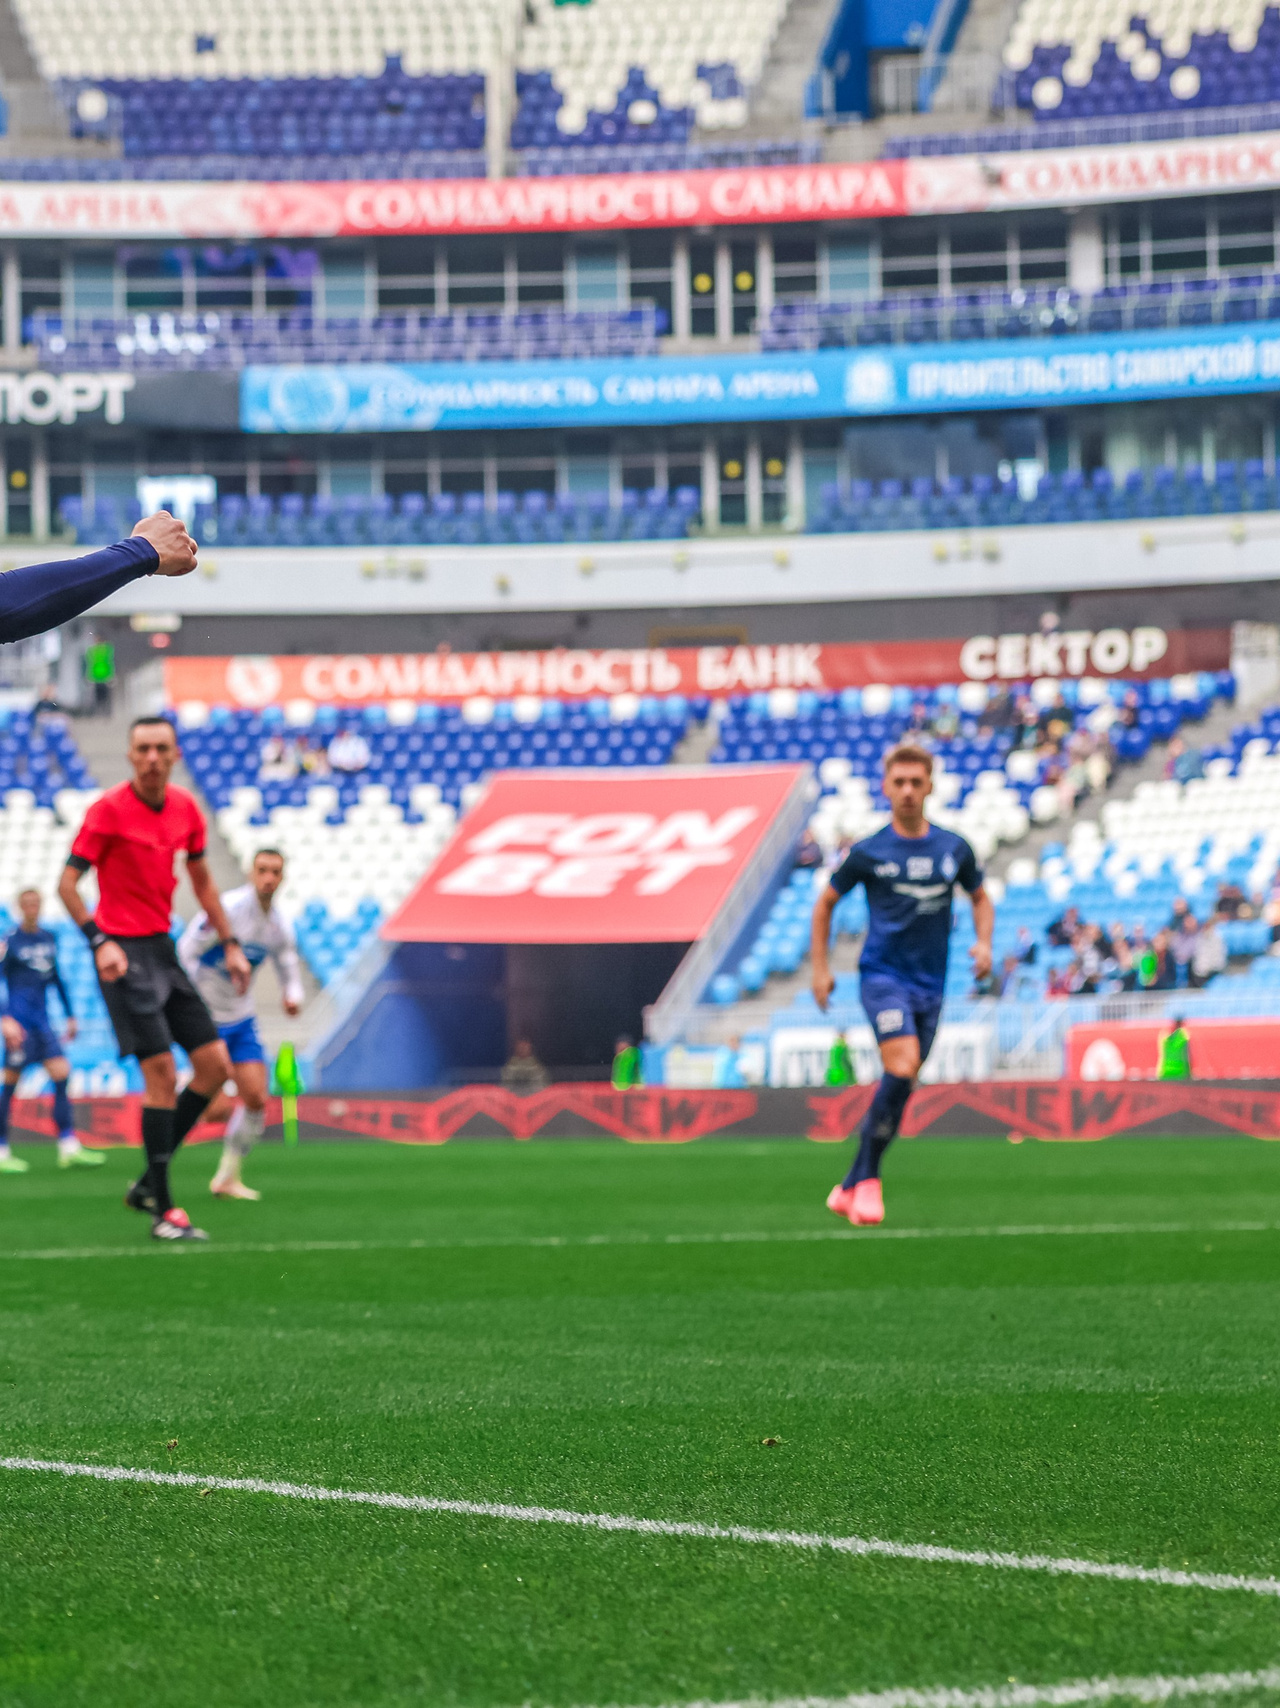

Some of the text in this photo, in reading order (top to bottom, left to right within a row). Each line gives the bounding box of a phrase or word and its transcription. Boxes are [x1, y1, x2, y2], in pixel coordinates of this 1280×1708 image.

[344, 165, 896, 229] СОЛИДАРНОСТЬ САМАРА
[302, 643, 822, 698] СОЛИДАРНОСТЬ БАНК
[959, 626, 1169, 680] СЕКТОР
[465, 805, 761, 858] FON
[434, 846, 735, 898] BET
